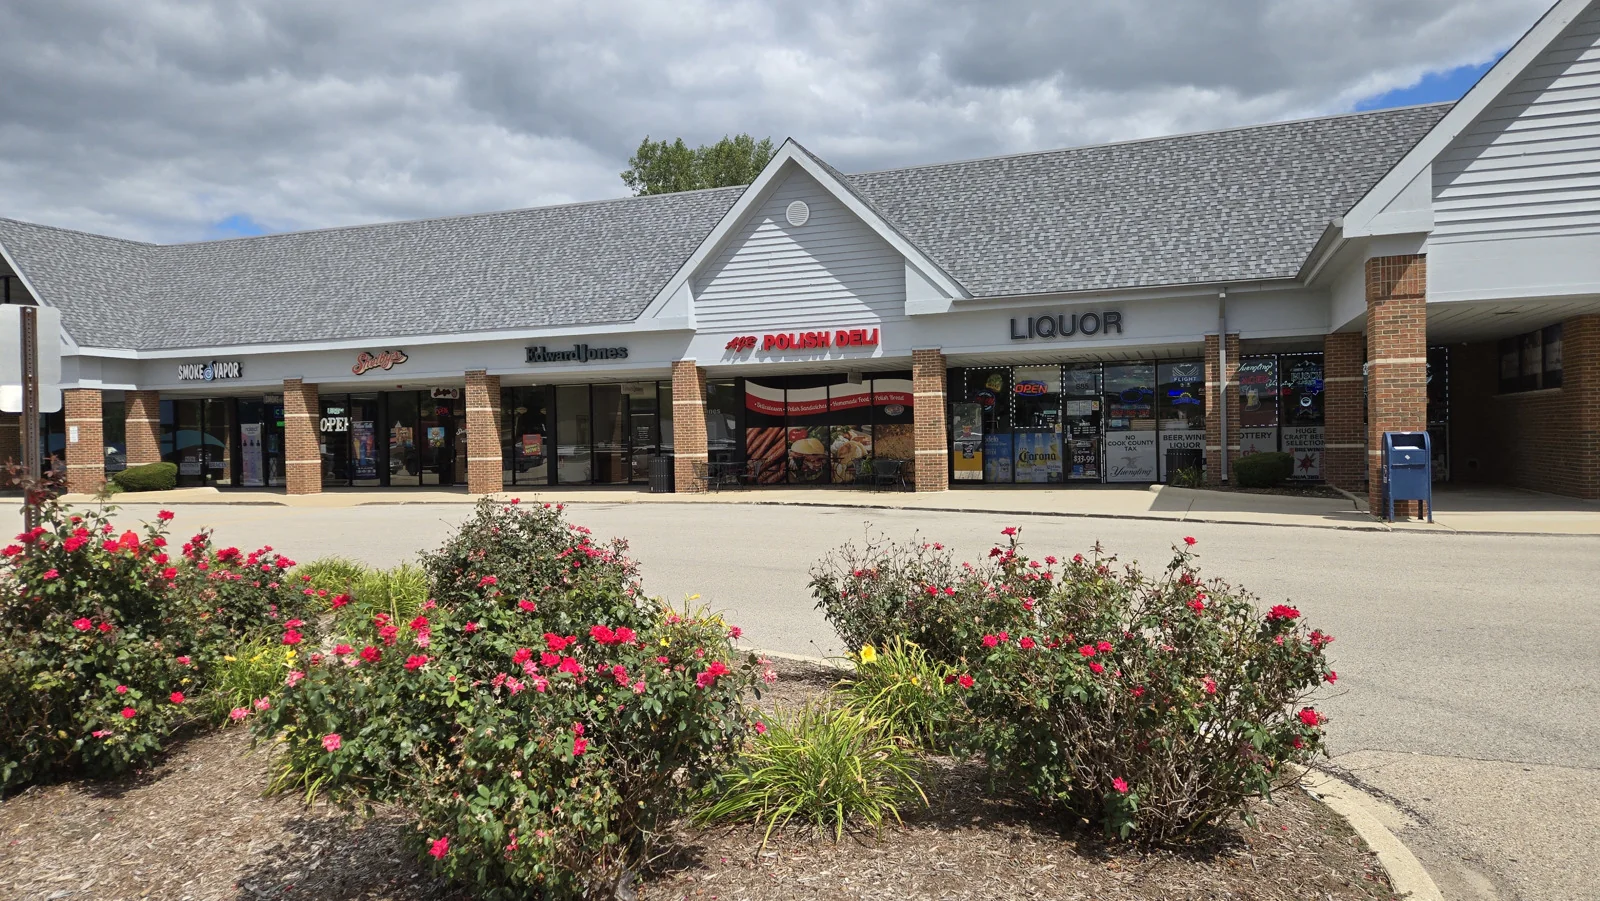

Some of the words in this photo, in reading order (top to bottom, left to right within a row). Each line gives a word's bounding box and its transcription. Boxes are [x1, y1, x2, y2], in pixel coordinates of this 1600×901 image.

[1010, 311, 1122, 340] LIQUOR
[763, 331, 831, 351] POLISH
[835, 328, 879, 346] DELI
[178, 364, 204, 380] SMOKE
[213, 362, 240, 379] VAPOR
[1014, 383, 1048, 394] OPEN
[832, 399, 857, 408] Homemade
[857, 396, 870, 404] Food
[1239, 432, 1273, 440] OTTERY
[1018, 450, 1057, 464] Corona
[1110, 465, 1154, 478] Yuengling
